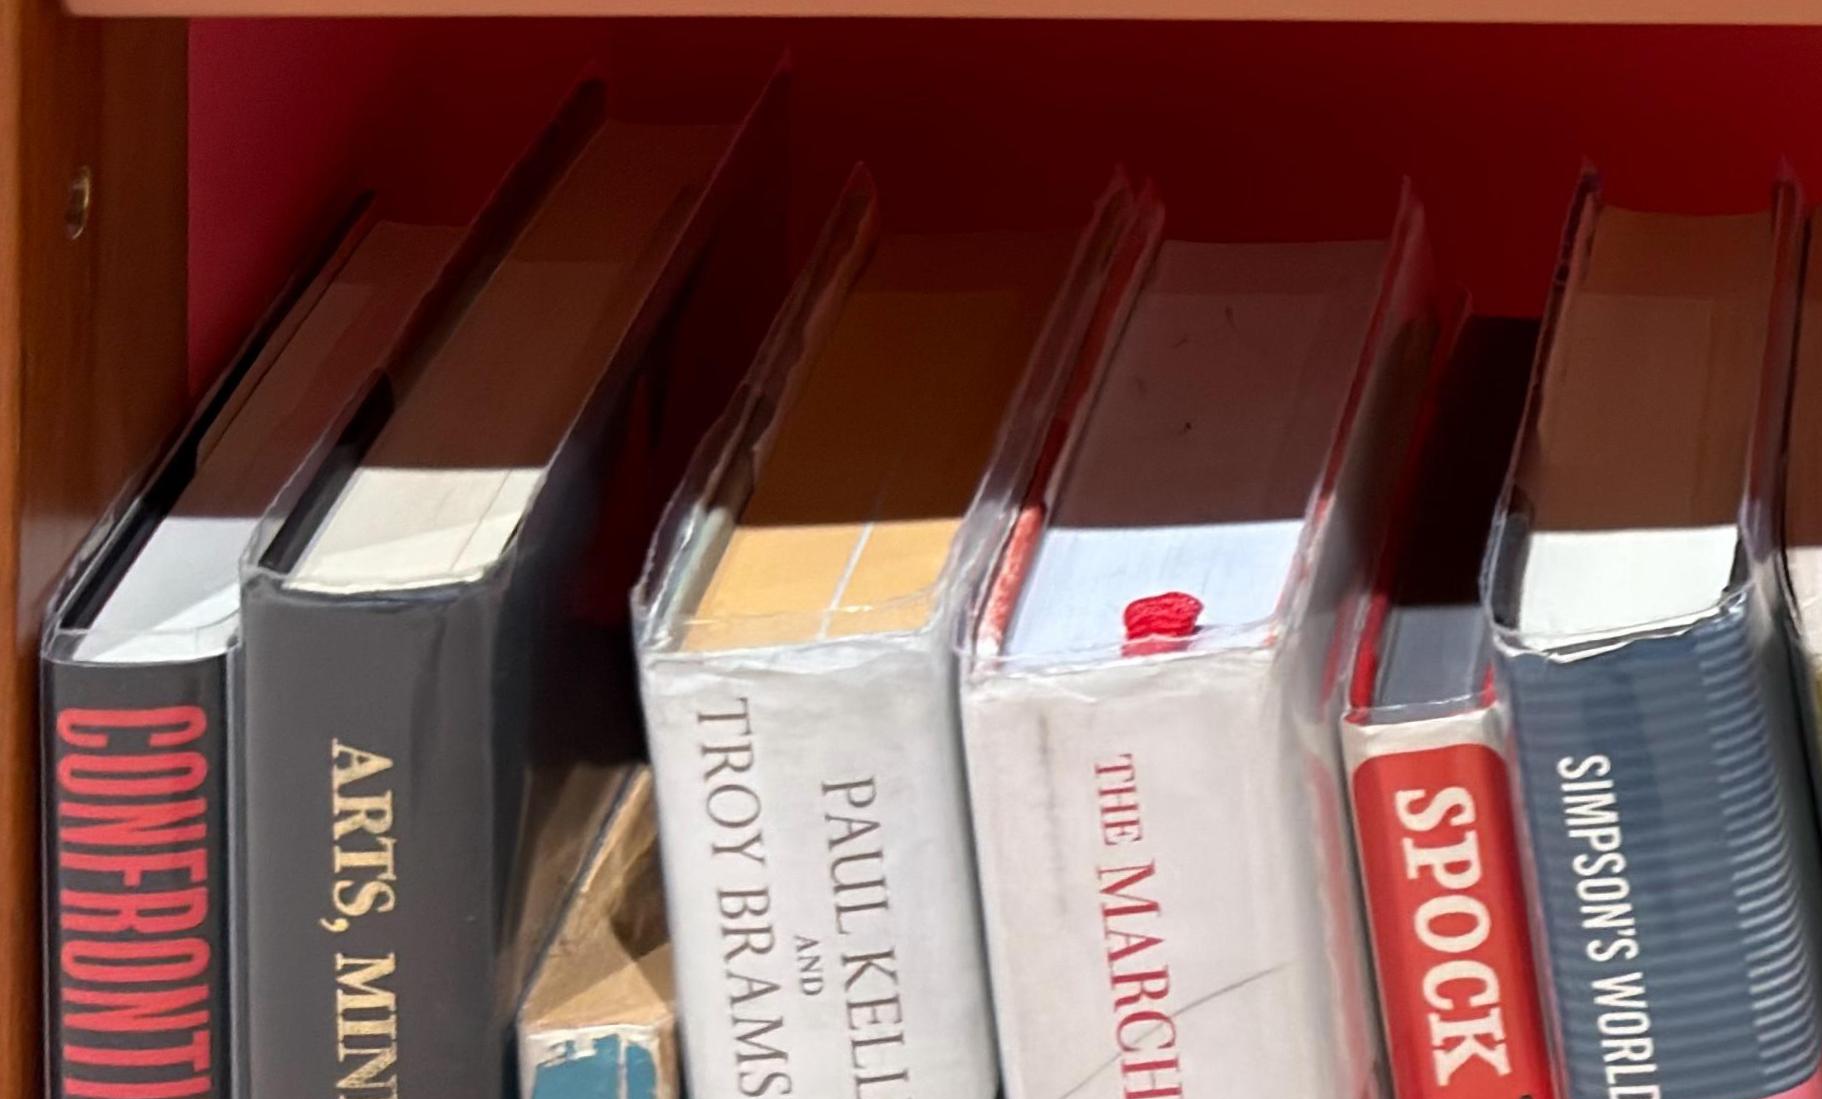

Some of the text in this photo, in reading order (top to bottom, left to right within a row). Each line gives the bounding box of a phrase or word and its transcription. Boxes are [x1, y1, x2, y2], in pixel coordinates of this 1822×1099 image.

[320, 737, 397, 933] ARTS,
[696, 697, 766, 867] TROY
[821, 775, 890, 935] PAUL
[1093, 752, 1143, 848] THE
[1555, 753, 1640, 963] SIMPSON'S
[793, 934, 826, 997] AND
[1395, 786, 1511, 1088] SPOCK
